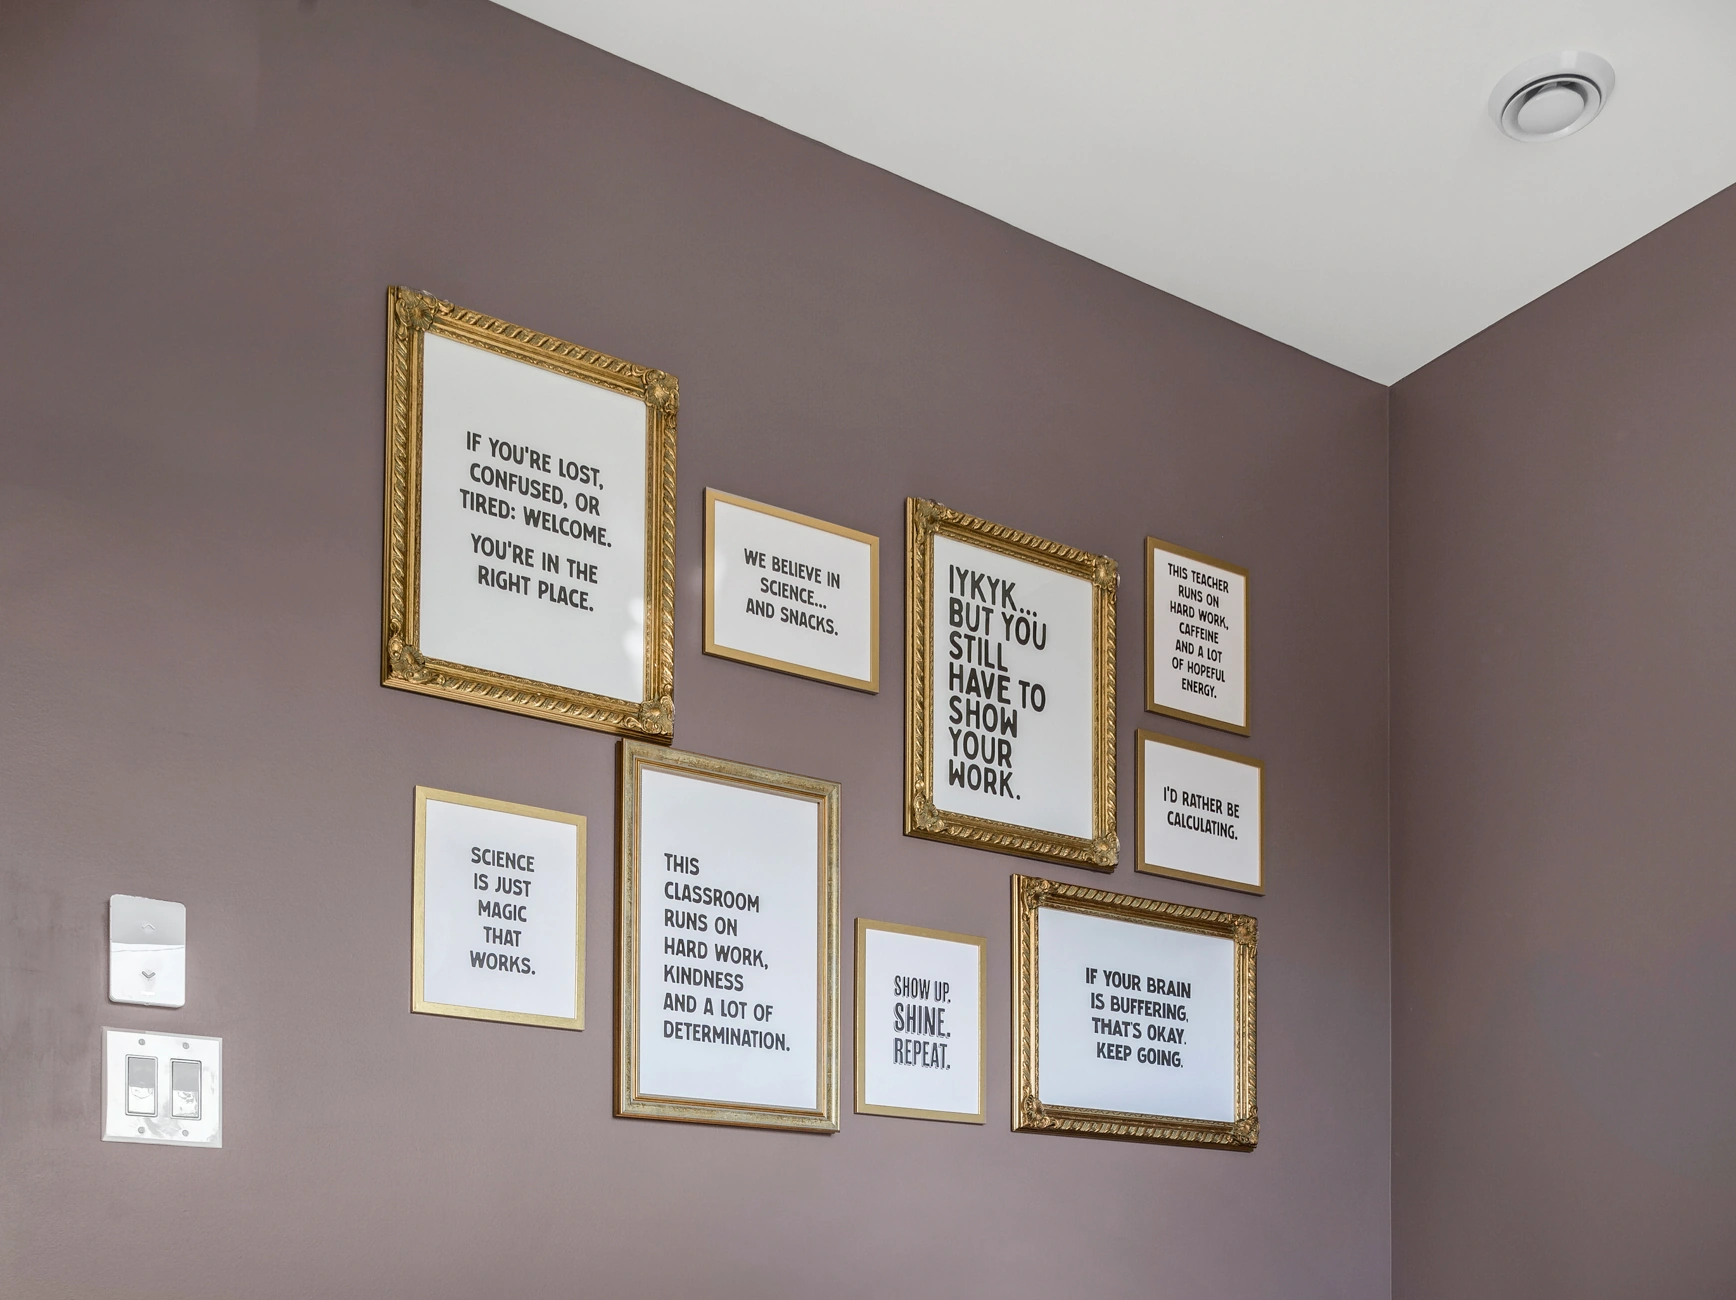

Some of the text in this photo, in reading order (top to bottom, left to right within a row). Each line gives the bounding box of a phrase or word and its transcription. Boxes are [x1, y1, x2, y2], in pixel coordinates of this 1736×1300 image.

[466, 430, 604, 491] IF YOU'RE LOST,
[469, 462, 601, 517] CONFUSED, OR
[459, 488, 612, 548] TIRED: WELCOME.
[470, 532, 598, 585] YOU'RE IN THE
[743, 547, 841, 590] WE BELIEVE IN
[477, 564, 594, 612] RIGHT PLACE.
[760, 576, 827, 610] SCIENCE...
[949, 564, 1038, 618] IYKYK...
[1167, 562, 1229, 594] THIS TEACHER
[1178, 584, 1220, 609] RUNS ON
[745, 597, 839, 637] AND SNACKS.
[949, 596, 1047, 651] BUT YOU
[1169, 600, 1229, 631] HARD WORK,
[1178, 621, 1219, 645] CAFFEINE
[948, 630, 1009, 673] STILL
[1175, 638, 1223, 664] AND A LOT
[1171, 656, 1226, 683] OF HOPEFUL
[948, 661, 1047, 713] HAVE TO
[1181, 677, 1217, 699] ENERGY.
[948, 694, 1018, 739] SHOW
[948, 726, 1013, 769] YOUR
[948, 758, 1021, 801] WORK.
[1163, 785, 1240, 819] I'D RATHER BE
[1167, 810, 1238, 841] CALCULATING.
[470, 846, 535, 873] SCIENCE
[663, 852, 700, 876] THIS
[473, 872, 532, 898] IS JUST
[664, 881, 760, 914] CLASSROOM
[478, 899, 528, 923] MAGIC
[664, 908, 738, 937] RUNS ON
[482, 925, 522, 948] THAT
[469, 949, 536, 976] WORKS.
[664, 936, 769, 971] HARD WORK,
[663, 964, 744, 992] KINDNESS
[893, 974, 952, 1004] SHOW UP.
[1085, 966, 1192, 999] IF YOUR BRAIN
[662, 992, 774, 1023] AND A LOT OF
[893, 1002, 951, 1039] SHINE.
[1090, 992, 1189, 1023] IS BUFFERING,
[663, 1019, 791, 1052] DETERMINATION.
[1091, 1016, 1187, 1046] THAT'S OKAY.
[893, 1037, 951, 1071] REPEAT.
[1096, 1041, 1184, 1069] KEEP GOING.
